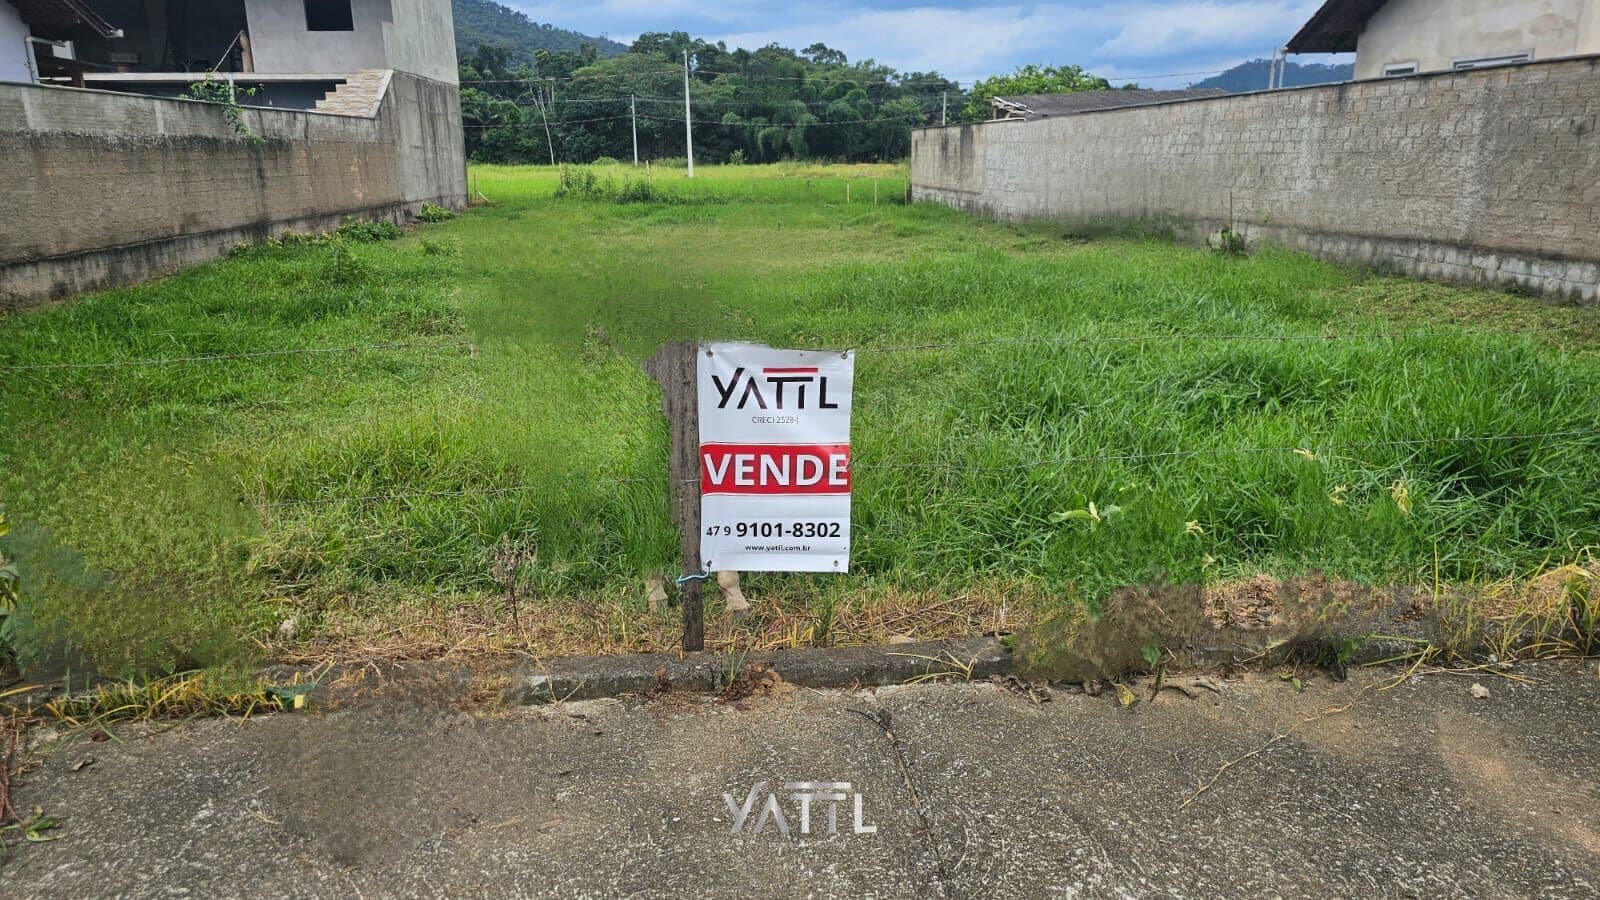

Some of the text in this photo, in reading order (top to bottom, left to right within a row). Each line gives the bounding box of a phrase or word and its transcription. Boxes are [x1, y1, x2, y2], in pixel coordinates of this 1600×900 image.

[751, 416, 775, 424] CRECI
[703, 453, 848, 486] VENDE
[706, 522, 841, 538] 47 9 9101-8302
[744, 544, 811, 552] www.yatil.com.br
